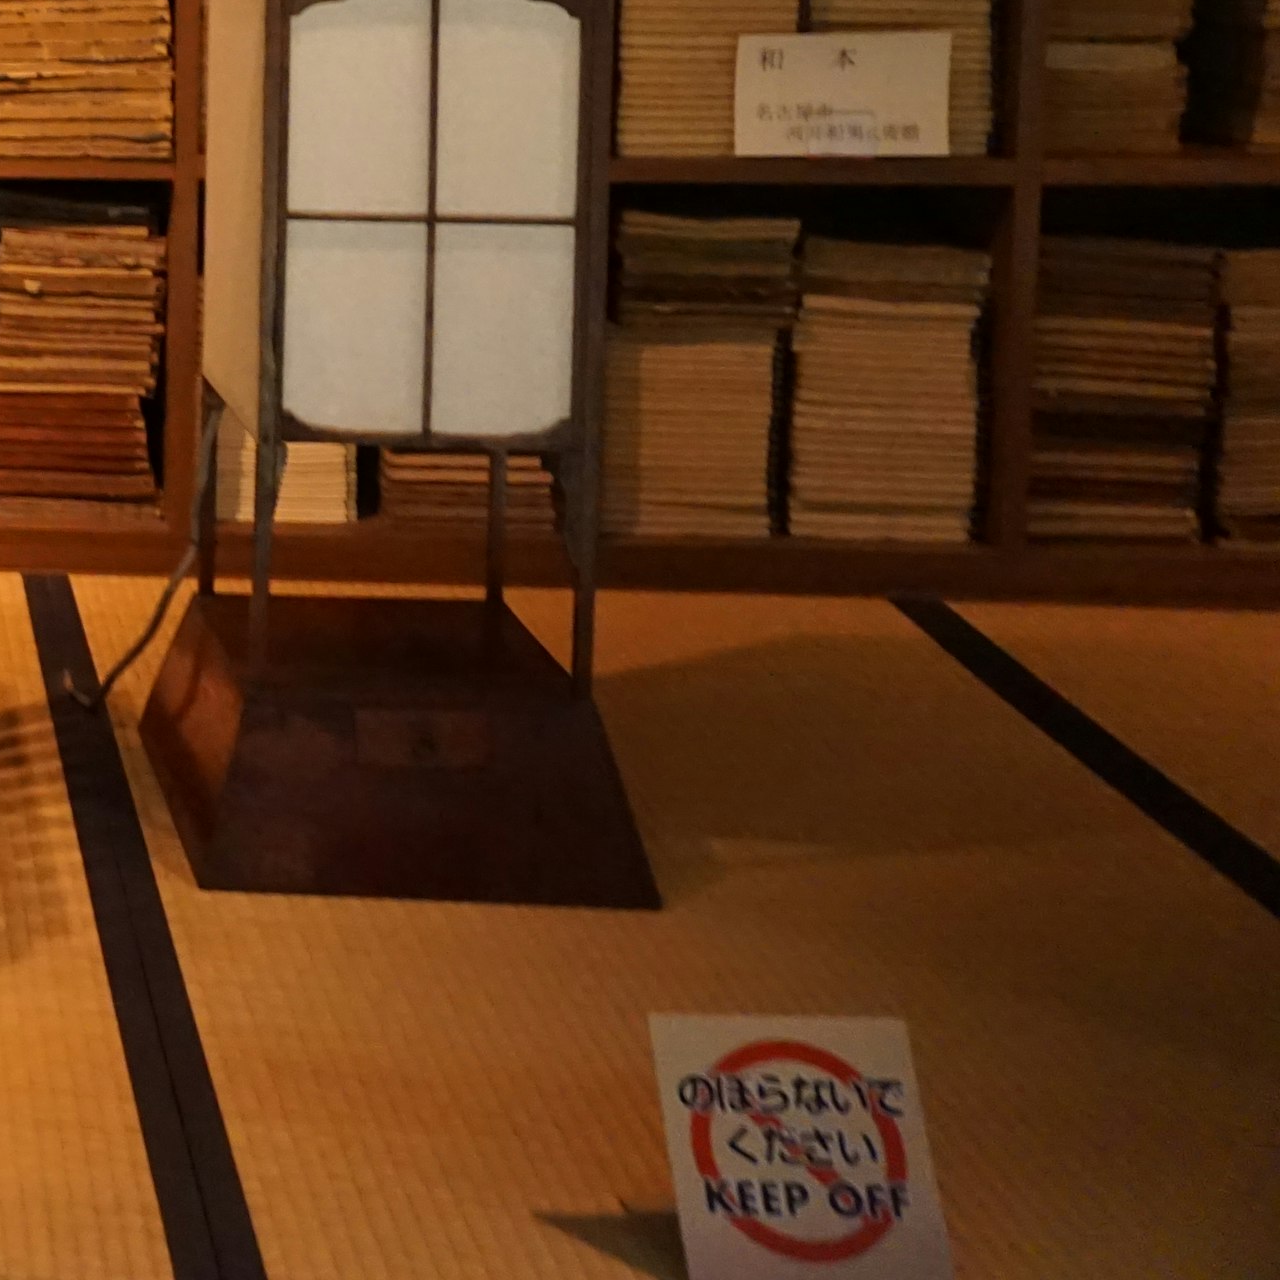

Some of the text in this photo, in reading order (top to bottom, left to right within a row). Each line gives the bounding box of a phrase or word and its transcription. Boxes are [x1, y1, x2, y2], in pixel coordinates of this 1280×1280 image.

[729, 1126, 878, 1166] ください
[704, 1179, 911, 1219] KEEP OFF
